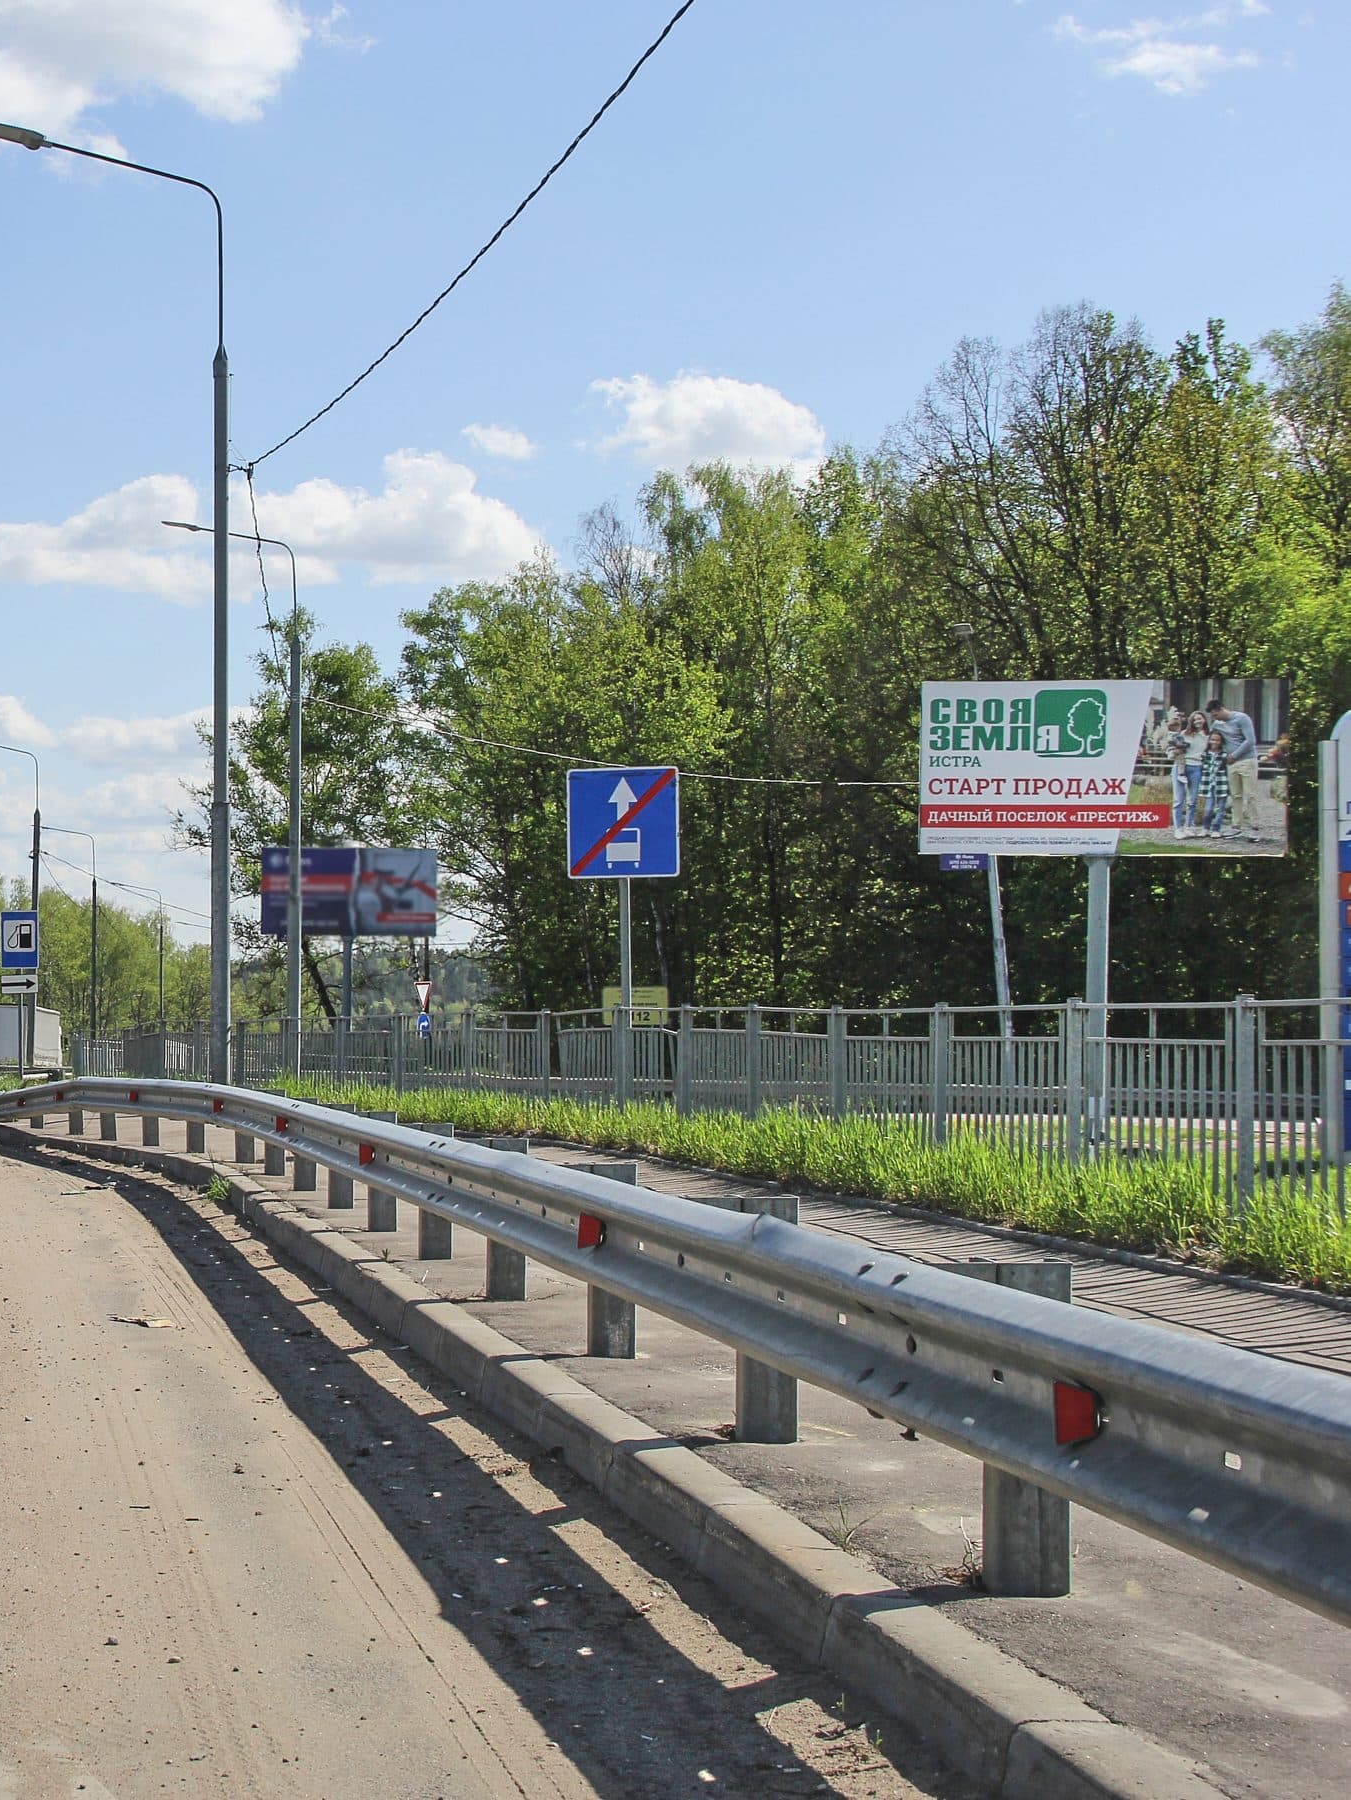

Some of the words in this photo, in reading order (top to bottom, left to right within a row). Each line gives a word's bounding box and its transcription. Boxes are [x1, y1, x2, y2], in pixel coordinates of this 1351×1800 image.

[930, 698, 1032, 724] СВОЯ
[929, 725, 1060, 751] ЗЕМЛЯ
[929, 755, 982, 767] ИСТРА
[928, 778, 1006, 795] СТАРТ
[1012, 778, 1127, 797] ПРОДАЖ
[928, 808, 992, 824] ДАЧНЫЙ
[996, 811, 1067, 823] ПОСЕЛОК
[1069, 811, 1160, 823] «ПРЕСТИЖ»
